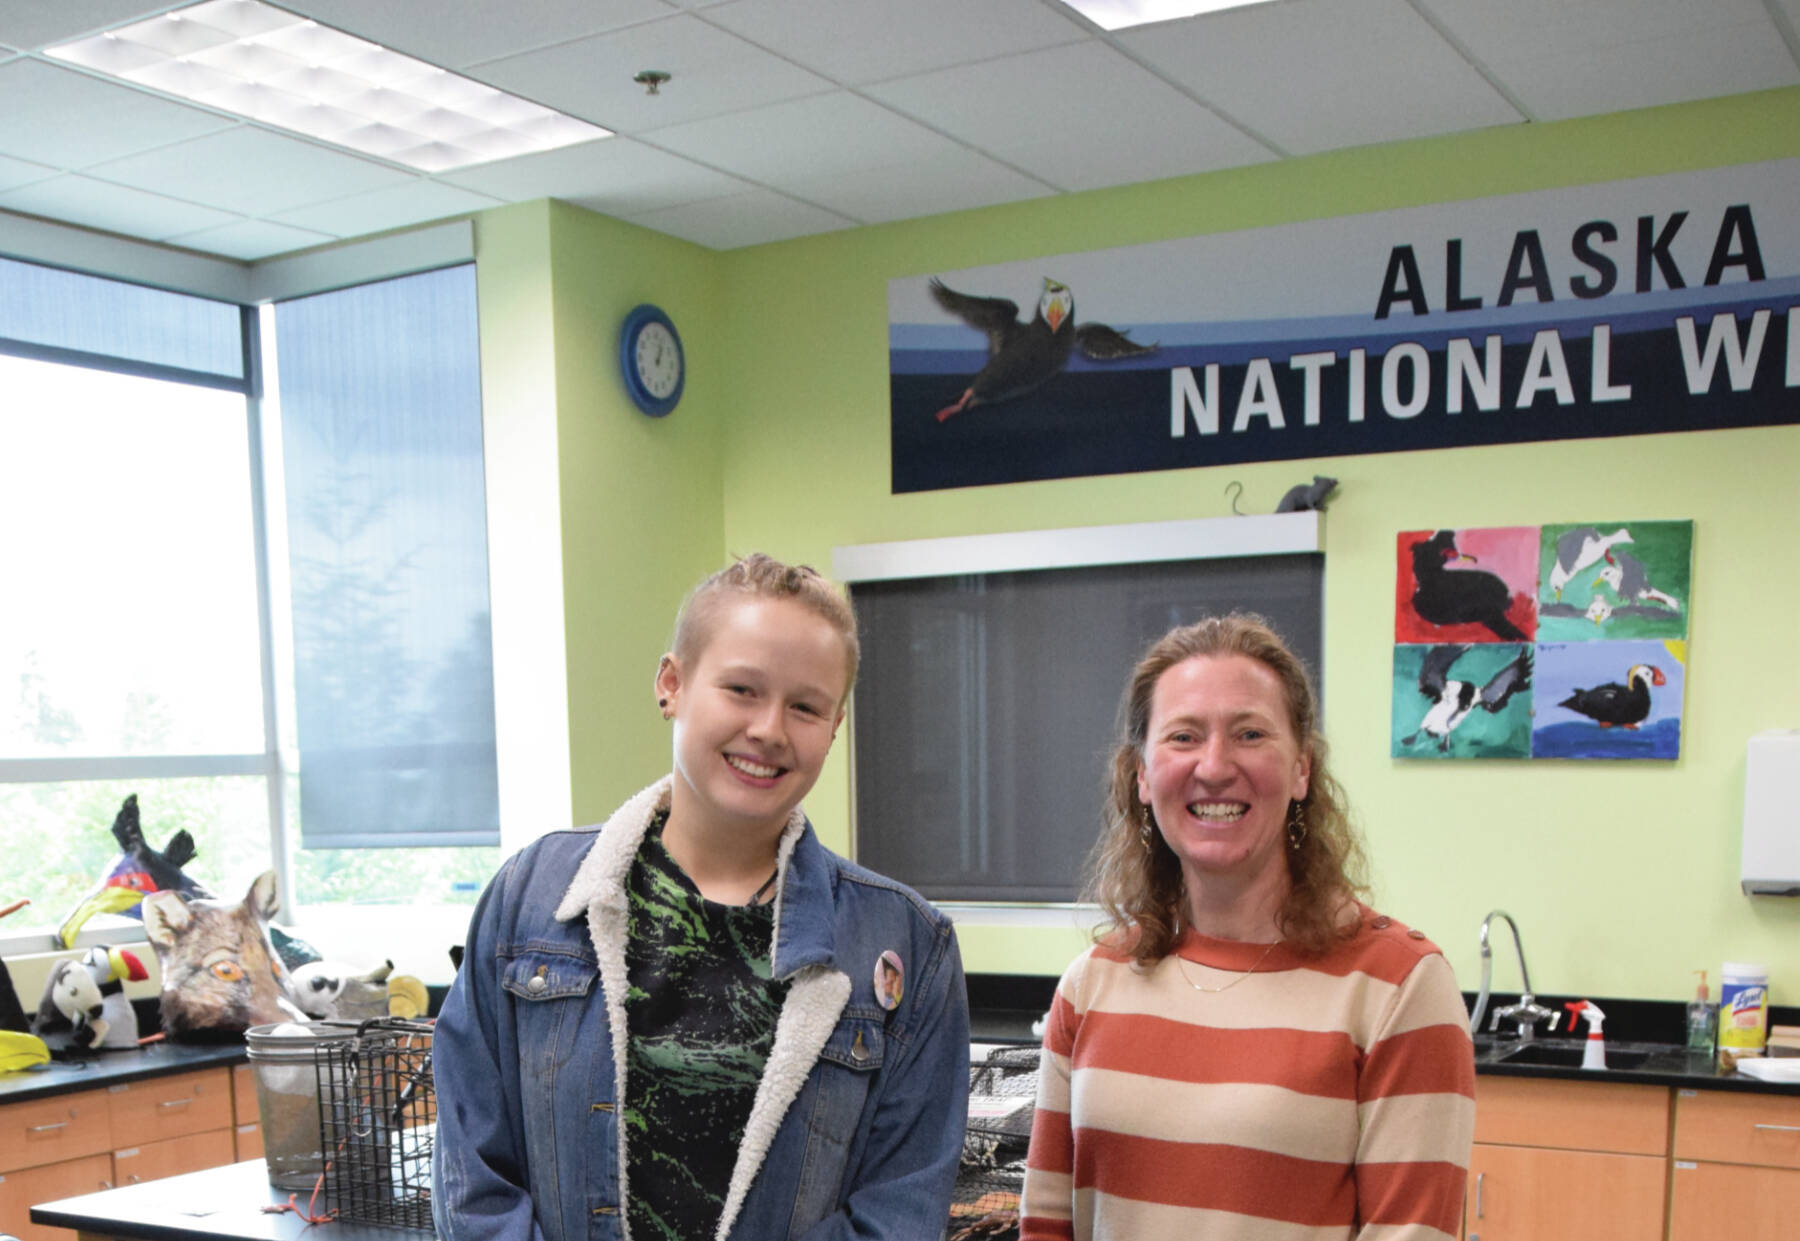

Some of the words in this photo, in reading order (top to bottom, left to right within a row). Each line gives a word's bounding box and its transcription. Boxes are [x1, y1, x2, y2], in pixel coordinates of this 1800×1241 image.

[1374, 203, 1767, 321] ALASKA
[1169, 323, 1633, 440] NATIONAL
[1676, 306, 1800, 396] WI
